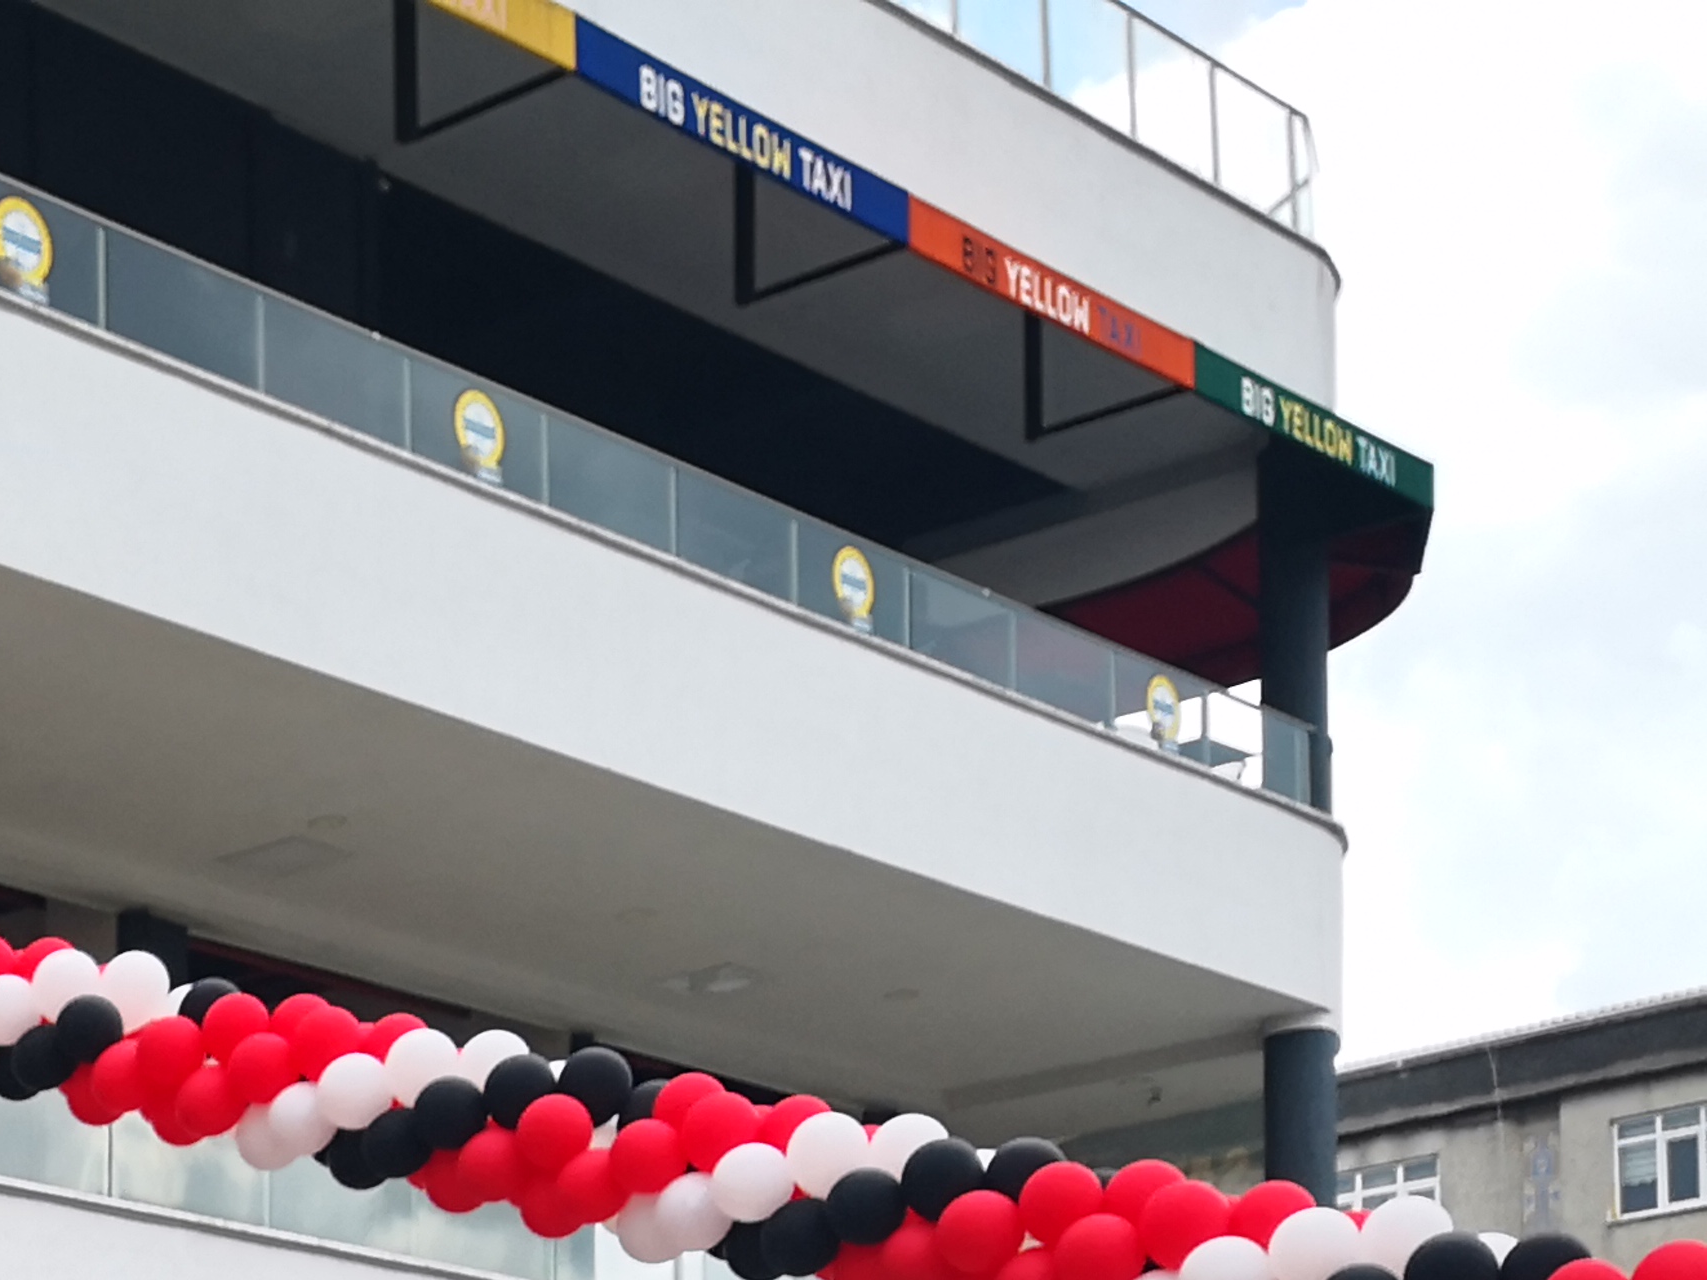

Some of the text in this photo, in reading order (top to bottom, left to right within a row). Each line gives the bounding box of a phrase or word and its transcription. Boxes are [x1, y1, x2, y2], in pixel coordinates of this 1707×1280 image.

[639, 65, 853, 212] BIG YELLOW TAXI
[1004, 256, 1091, 336] YELLOW
[1240, 375, 1397, 486] BIG YELLOW TAXI
